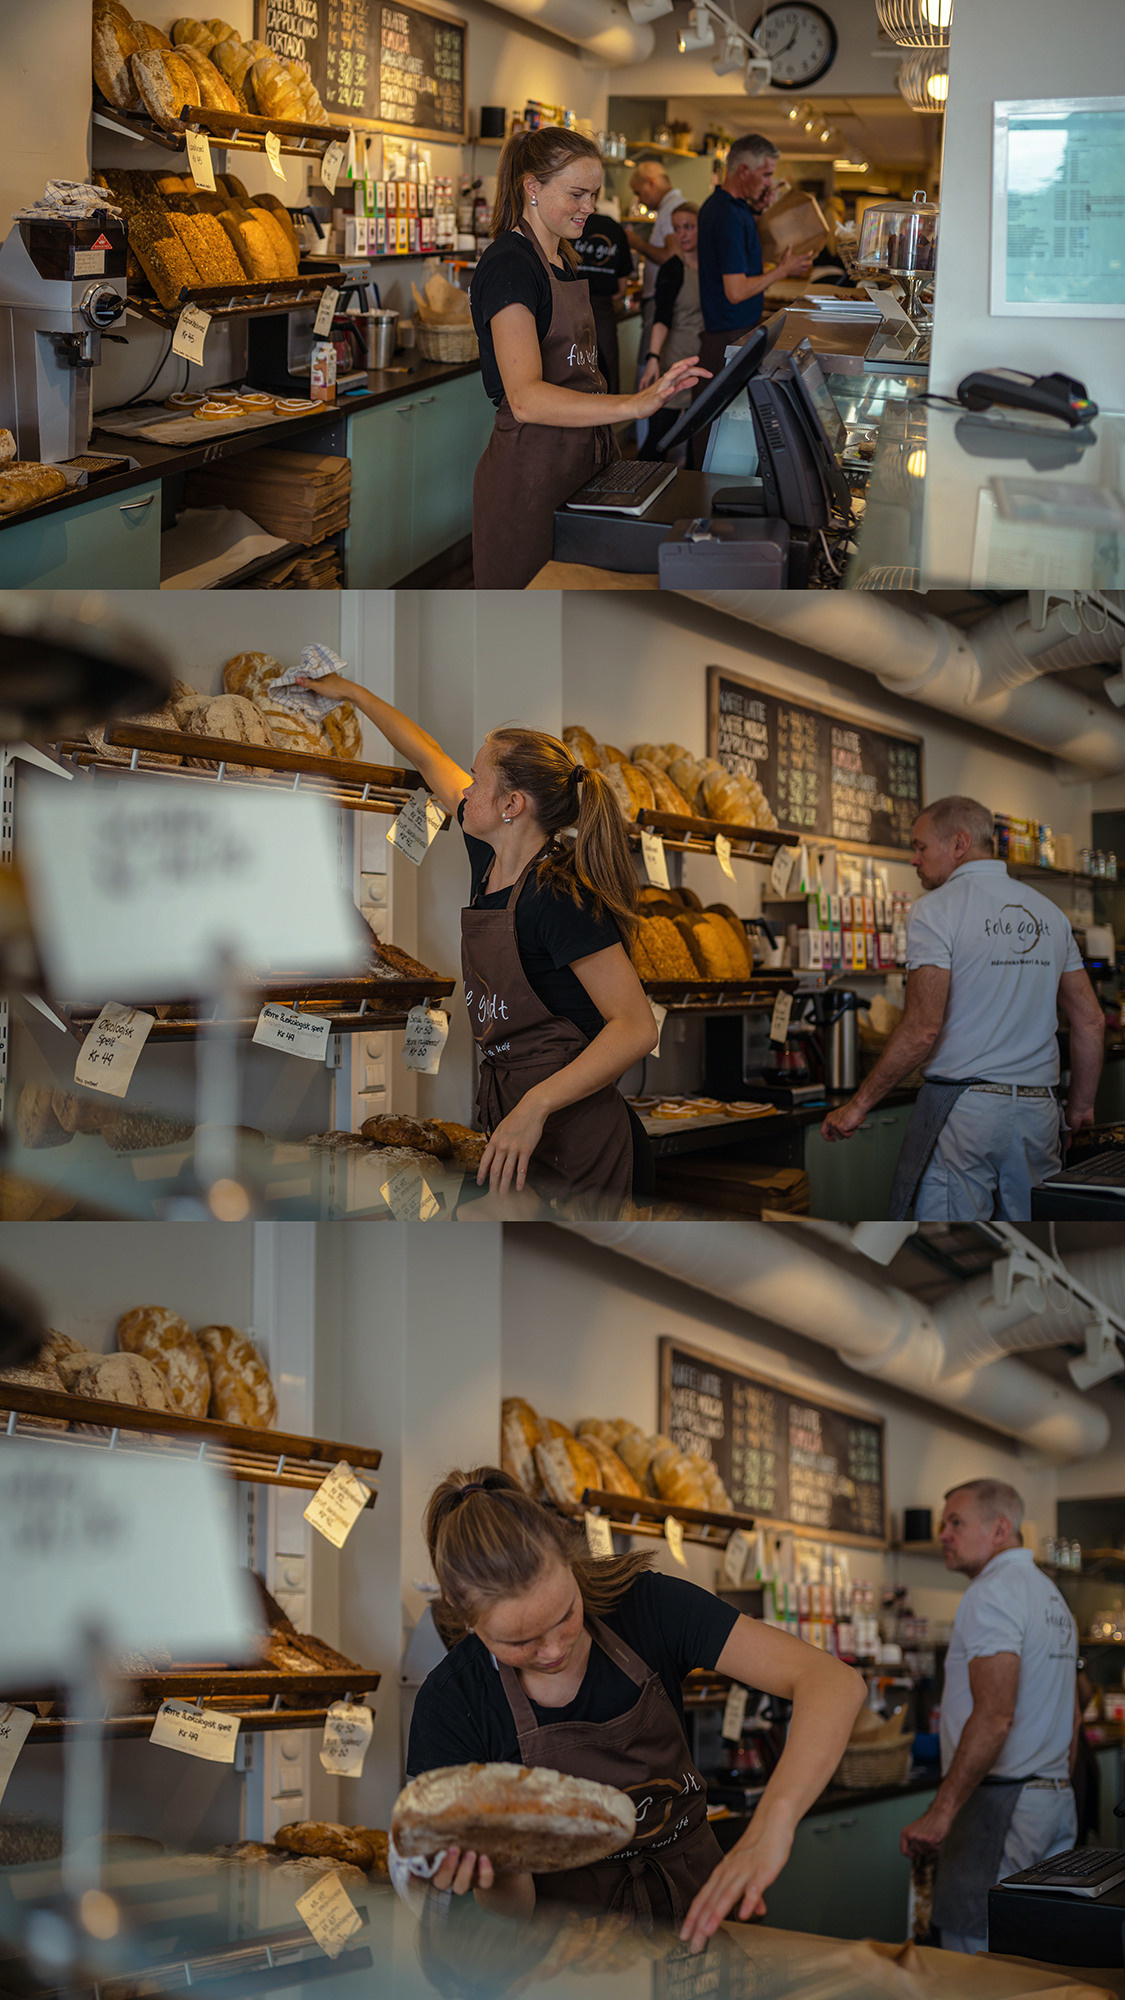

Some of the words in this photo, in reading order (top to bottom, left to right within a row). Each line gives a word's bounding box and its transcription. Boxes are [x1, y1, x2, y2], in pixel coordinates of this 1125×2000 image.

[266, 8, 319, 39] CAPPUCCINO
[266, 30, 307, 61] CORTADO
[98, 1018, 135, 1039] Økologisk
[88, 1048, 100, 1062] Kr
[101, 1051, 115, 1066] 49
